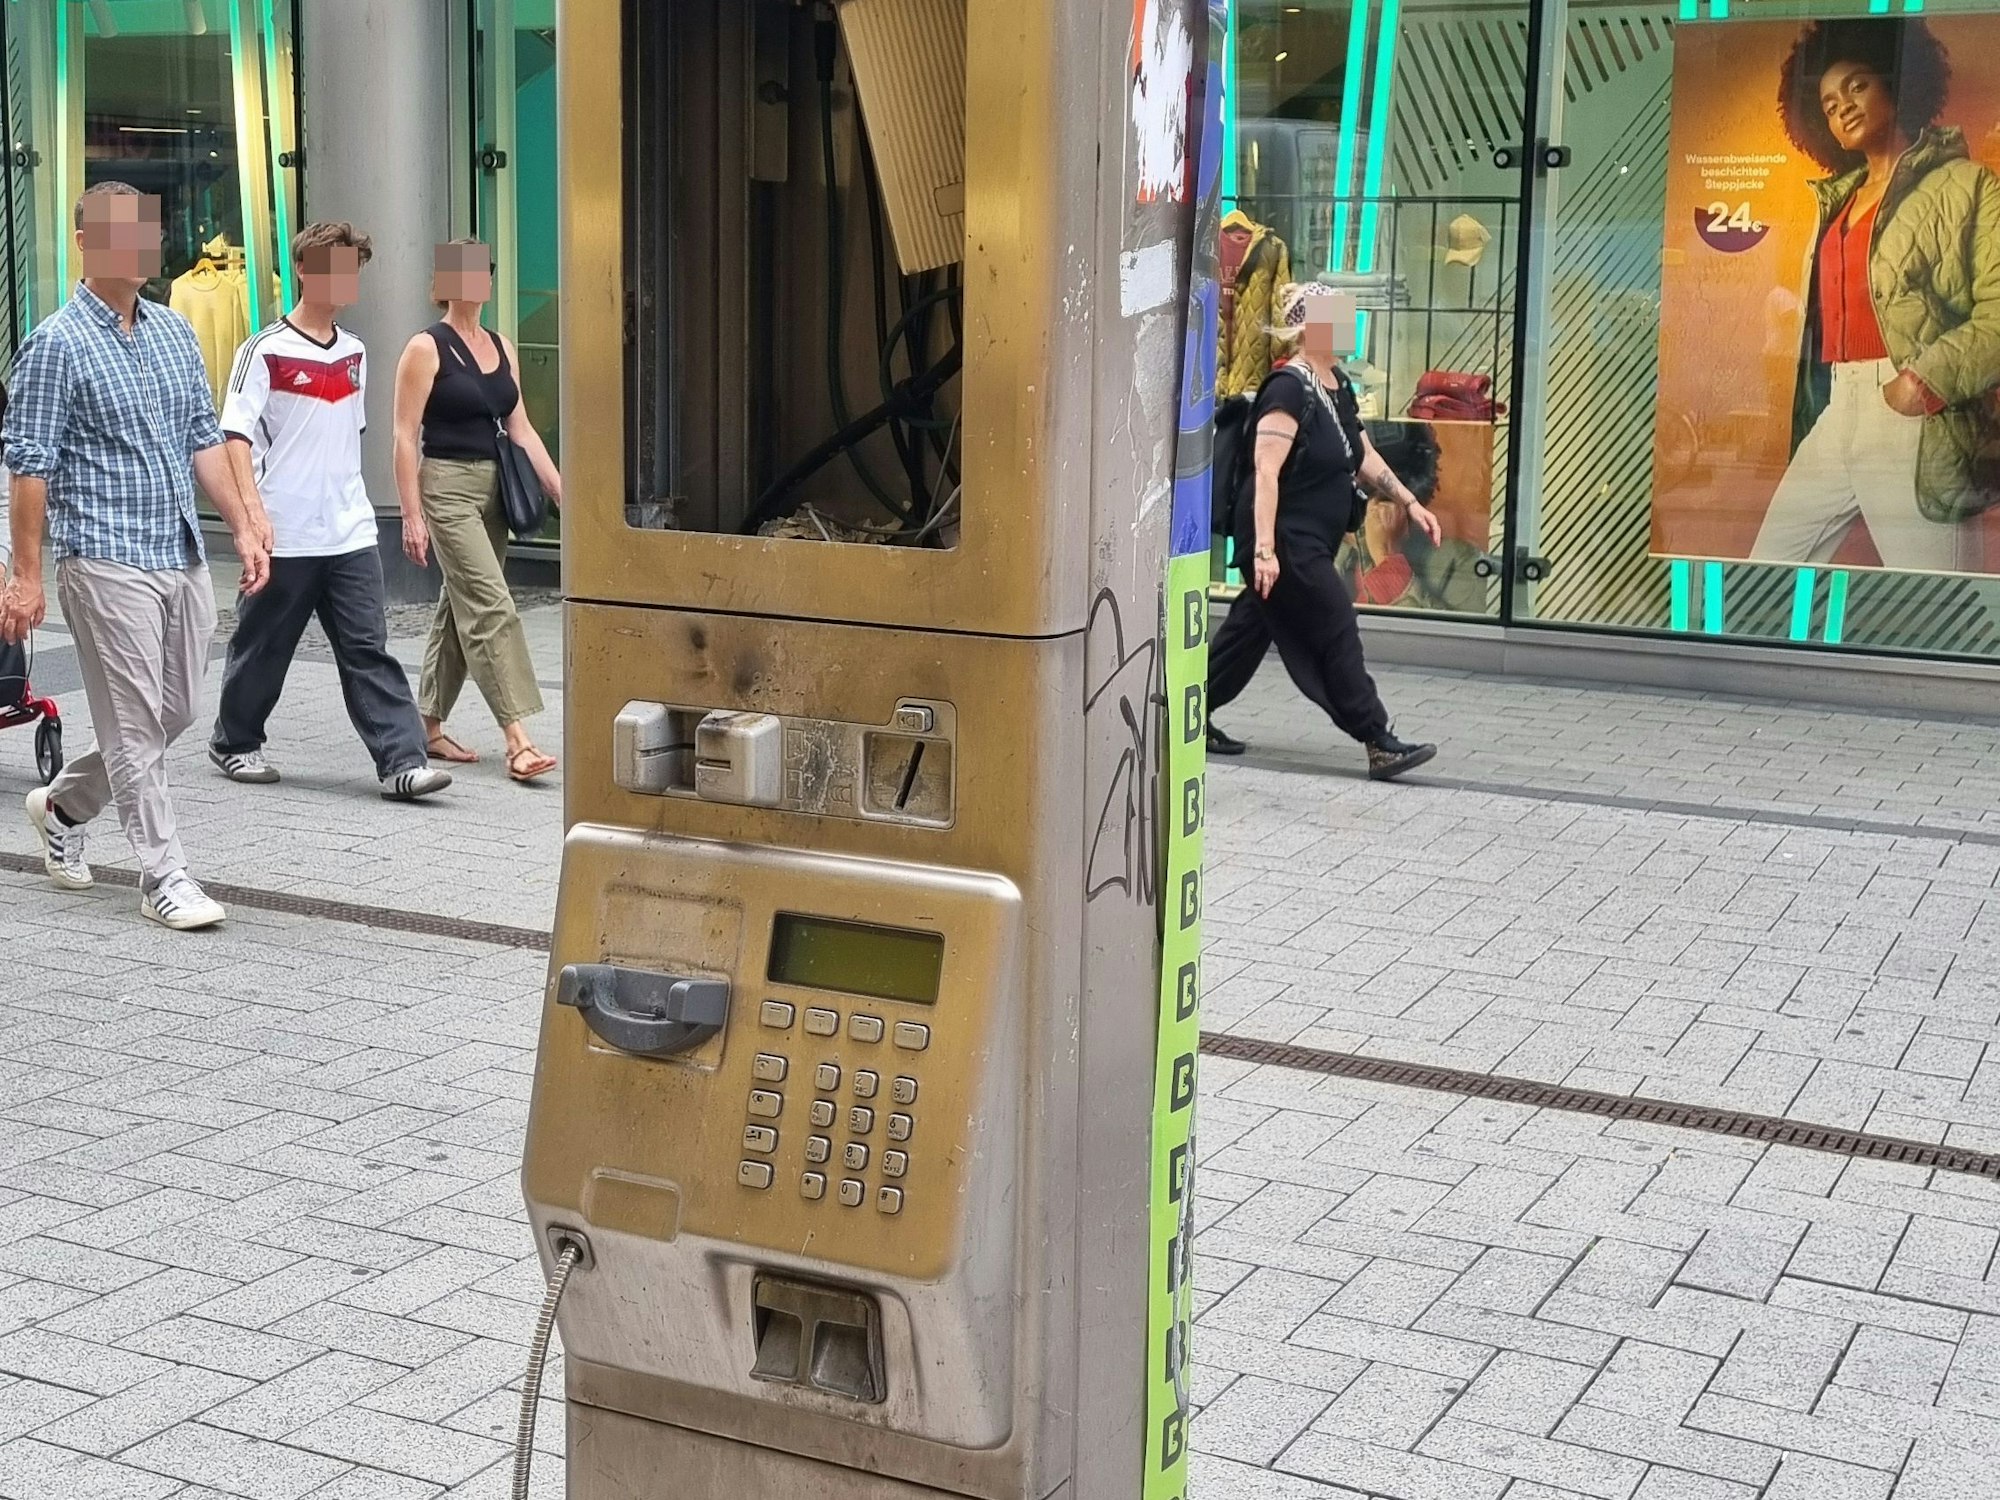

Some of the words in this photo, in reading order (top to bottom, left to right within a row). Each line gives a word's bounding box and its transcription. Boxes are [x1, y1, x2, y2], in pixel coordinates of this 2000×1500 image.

[1685, 153, 1788, 165] Wasserabweisende
[1701, 166, 1770, 177] beschichtete
[1705, 178, 1766, 191] Steppjacke
